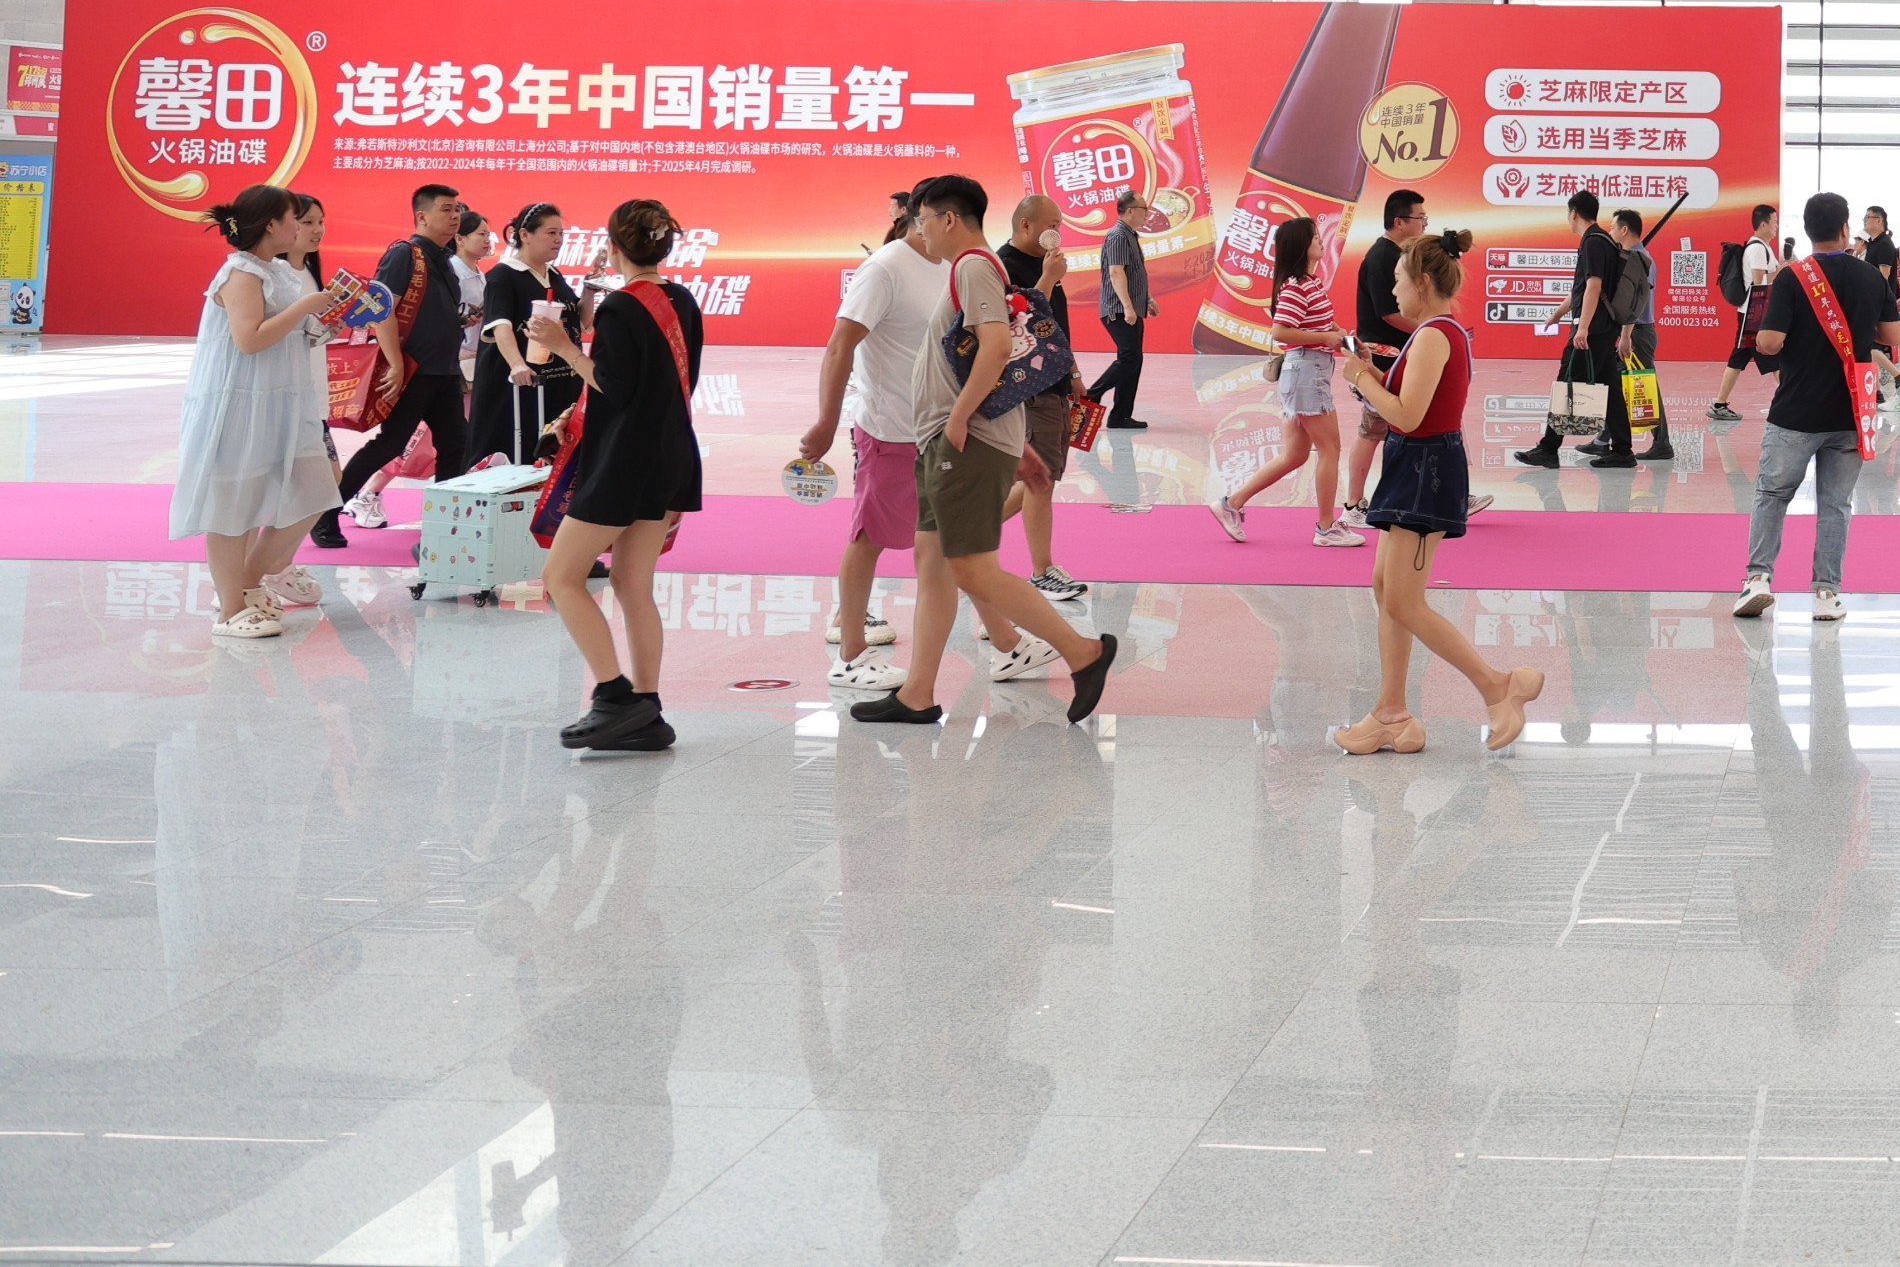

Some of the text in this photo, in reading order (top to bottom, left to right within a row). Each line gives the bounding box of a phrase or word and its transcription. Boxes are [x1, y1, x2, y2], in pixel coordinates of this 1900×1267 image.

[135, 57, 283, 131] 馨田
[333, 61, 976, 132] 连续3年中国销量第一
[1538, 80, 1688, 104] 芝麻限定产区
[1381, 102, 1426, 117] 连续3年
[1381, 114, 1425, 128] 中国销量
[1372, 96, 1449, 165] No.1
[1537, 126, 1688, 151] 选用当季芝麻
[148, 138, 268, 165] 火锅油碟
[10, 165, 48, 176] 苏宁小店
[1052, 143, 1135, 192] 馨田
[1536, 173, 1689, 198] 芝麻油低温压榨
[1224, 250, 1275, 279] 火锅油
[398, 246, 427, 324] 优质毛肚工
[1658, 317, 1720, 327] 4000 023 024
[1663, 305, 1716, 315] 全国服务热线
